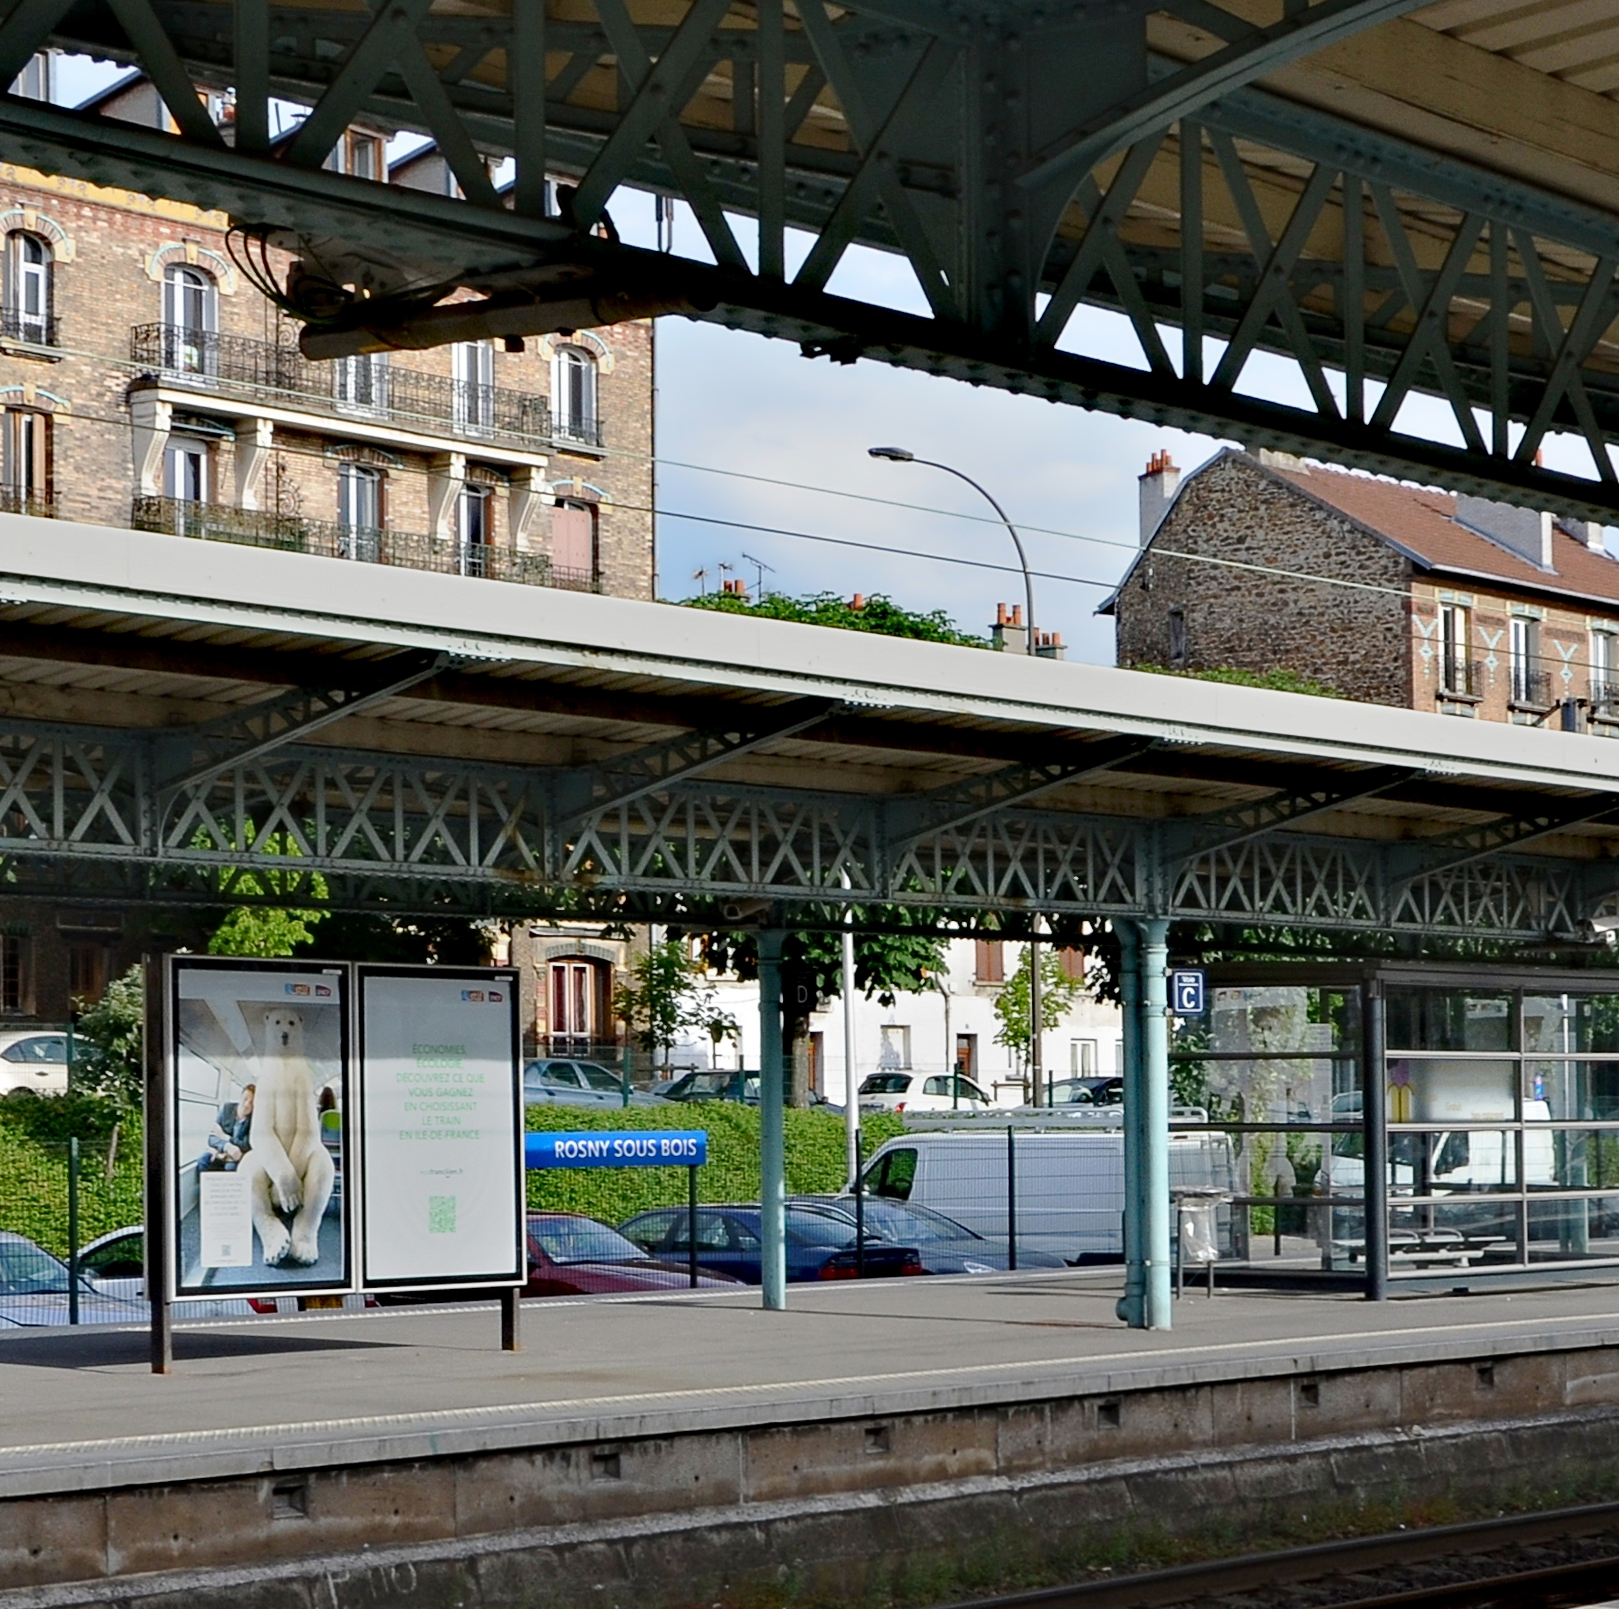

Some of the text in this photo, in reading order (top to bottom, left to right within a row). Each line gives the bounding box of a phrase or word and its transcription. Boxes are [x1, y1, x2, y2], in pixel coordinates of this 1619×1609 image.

[797, 985, 808, 1003] D
[1182, 987, 1196, 1008] C
[396, 1071, 485, 1083] DÉCOUVREZ CE QUE
[408, 1087, 474, 1097] VOUS GAGNEZ
[404, 1101, 477, 1111] EN CHOISISSANT
[422, 1116, 461, 1126] LE TRAIN
[399, 1129, 412, 1140] EN
[554, 1138, 697, 1159] ROSNY SOUS BOIS
